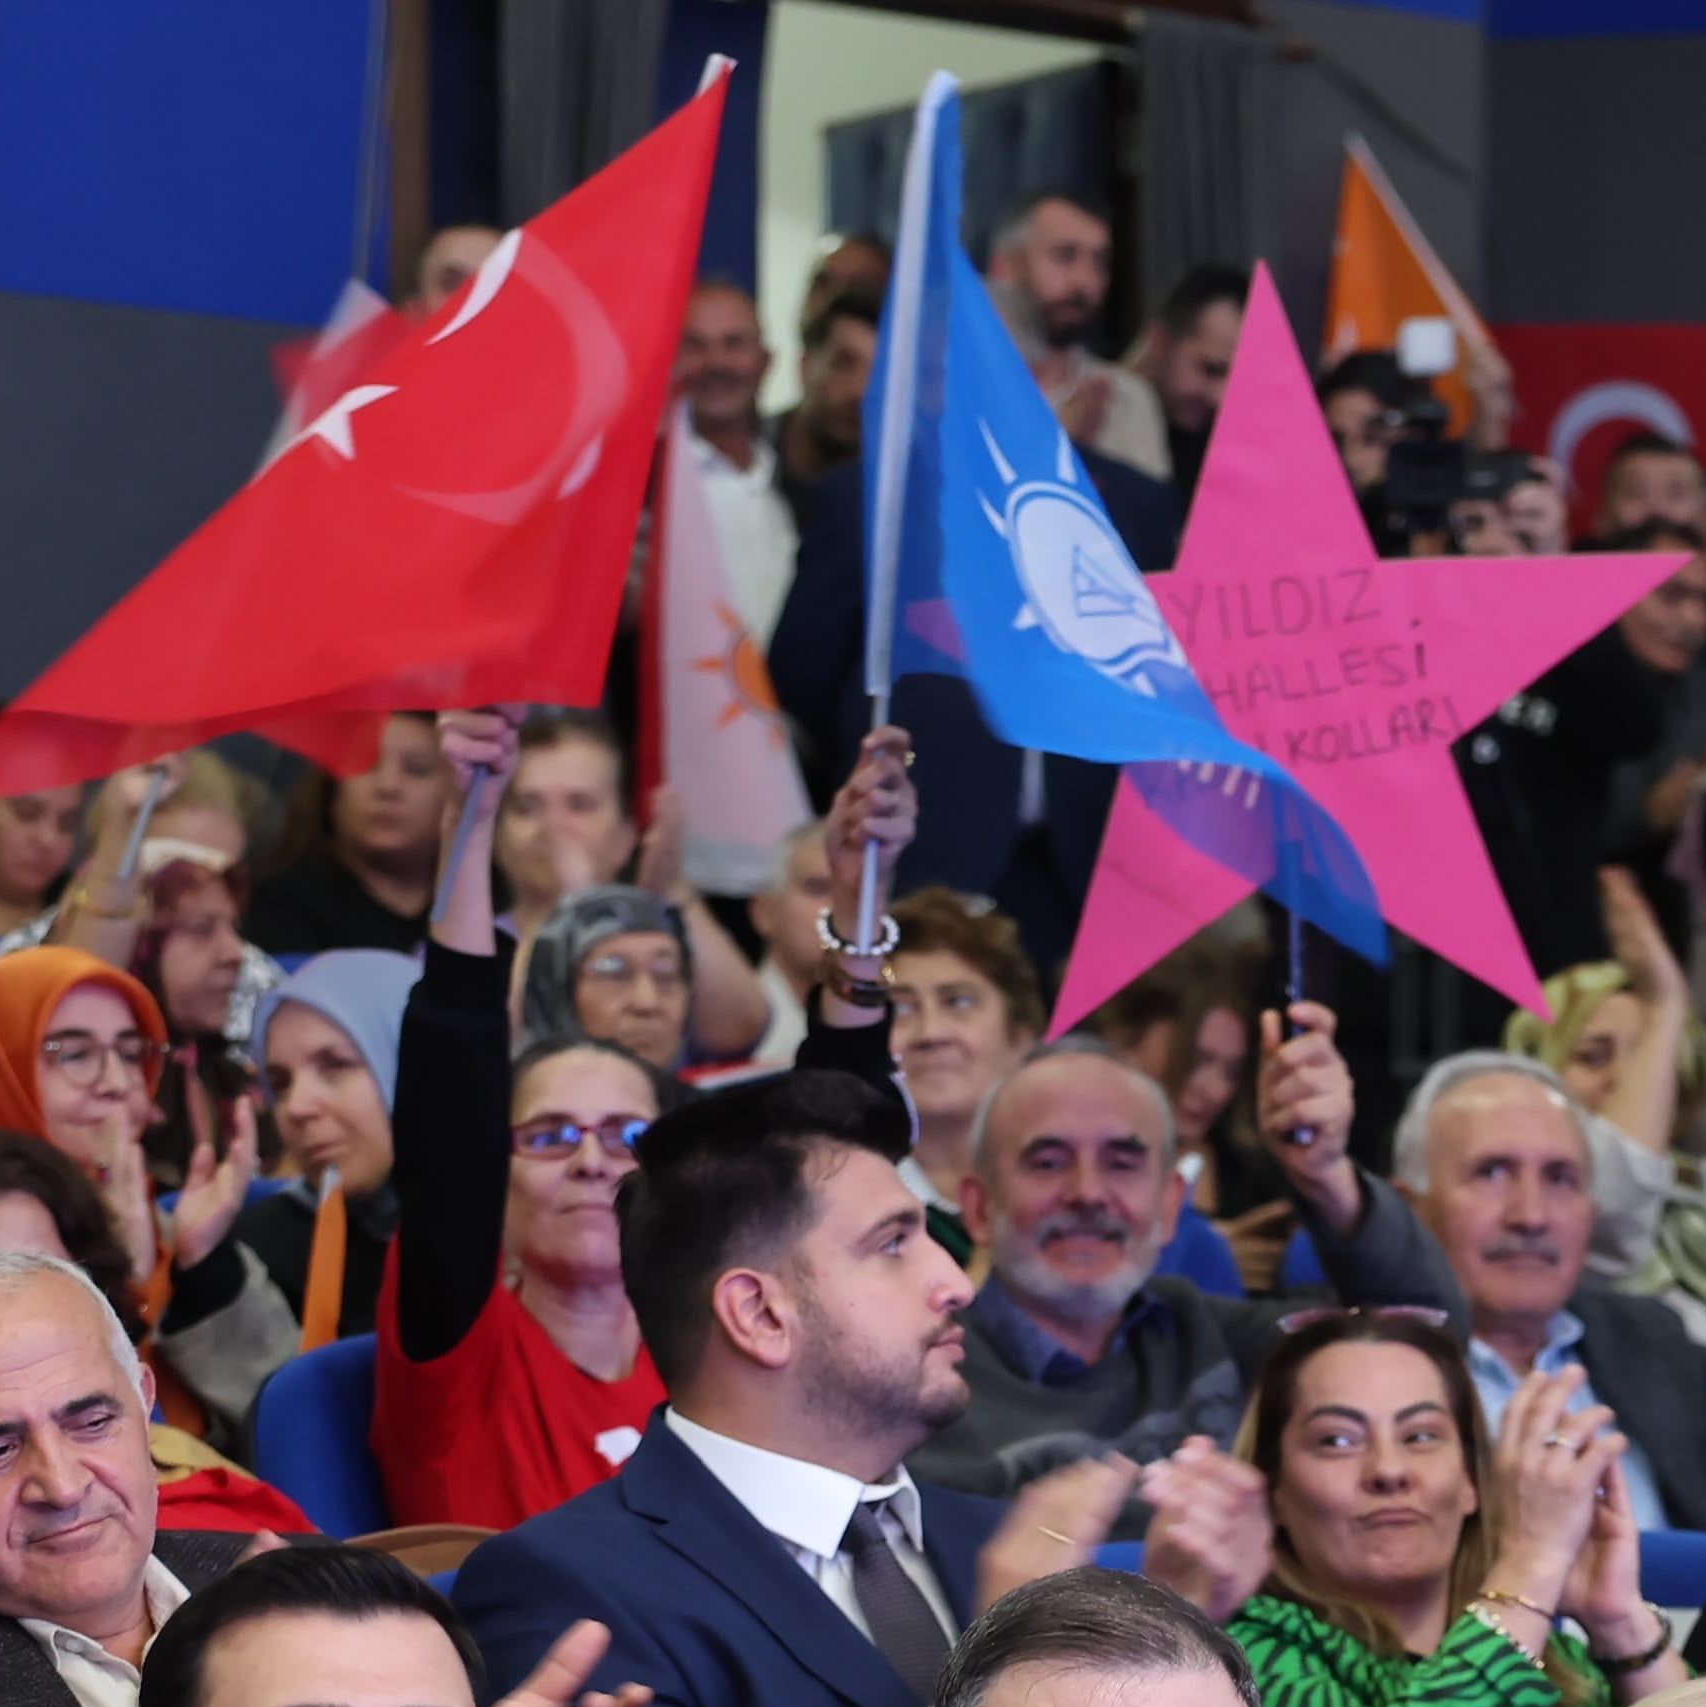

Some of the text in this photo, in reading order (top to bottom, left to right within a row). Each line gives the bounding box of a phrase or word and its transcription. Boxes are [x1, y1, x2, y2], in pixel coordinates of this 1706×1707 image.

[1169, 567, 1381, 648] YILDIZ
[1202, 616, 1429, 712] HALLESİ
[1282, 695, 1460, 766] KOLLARI
